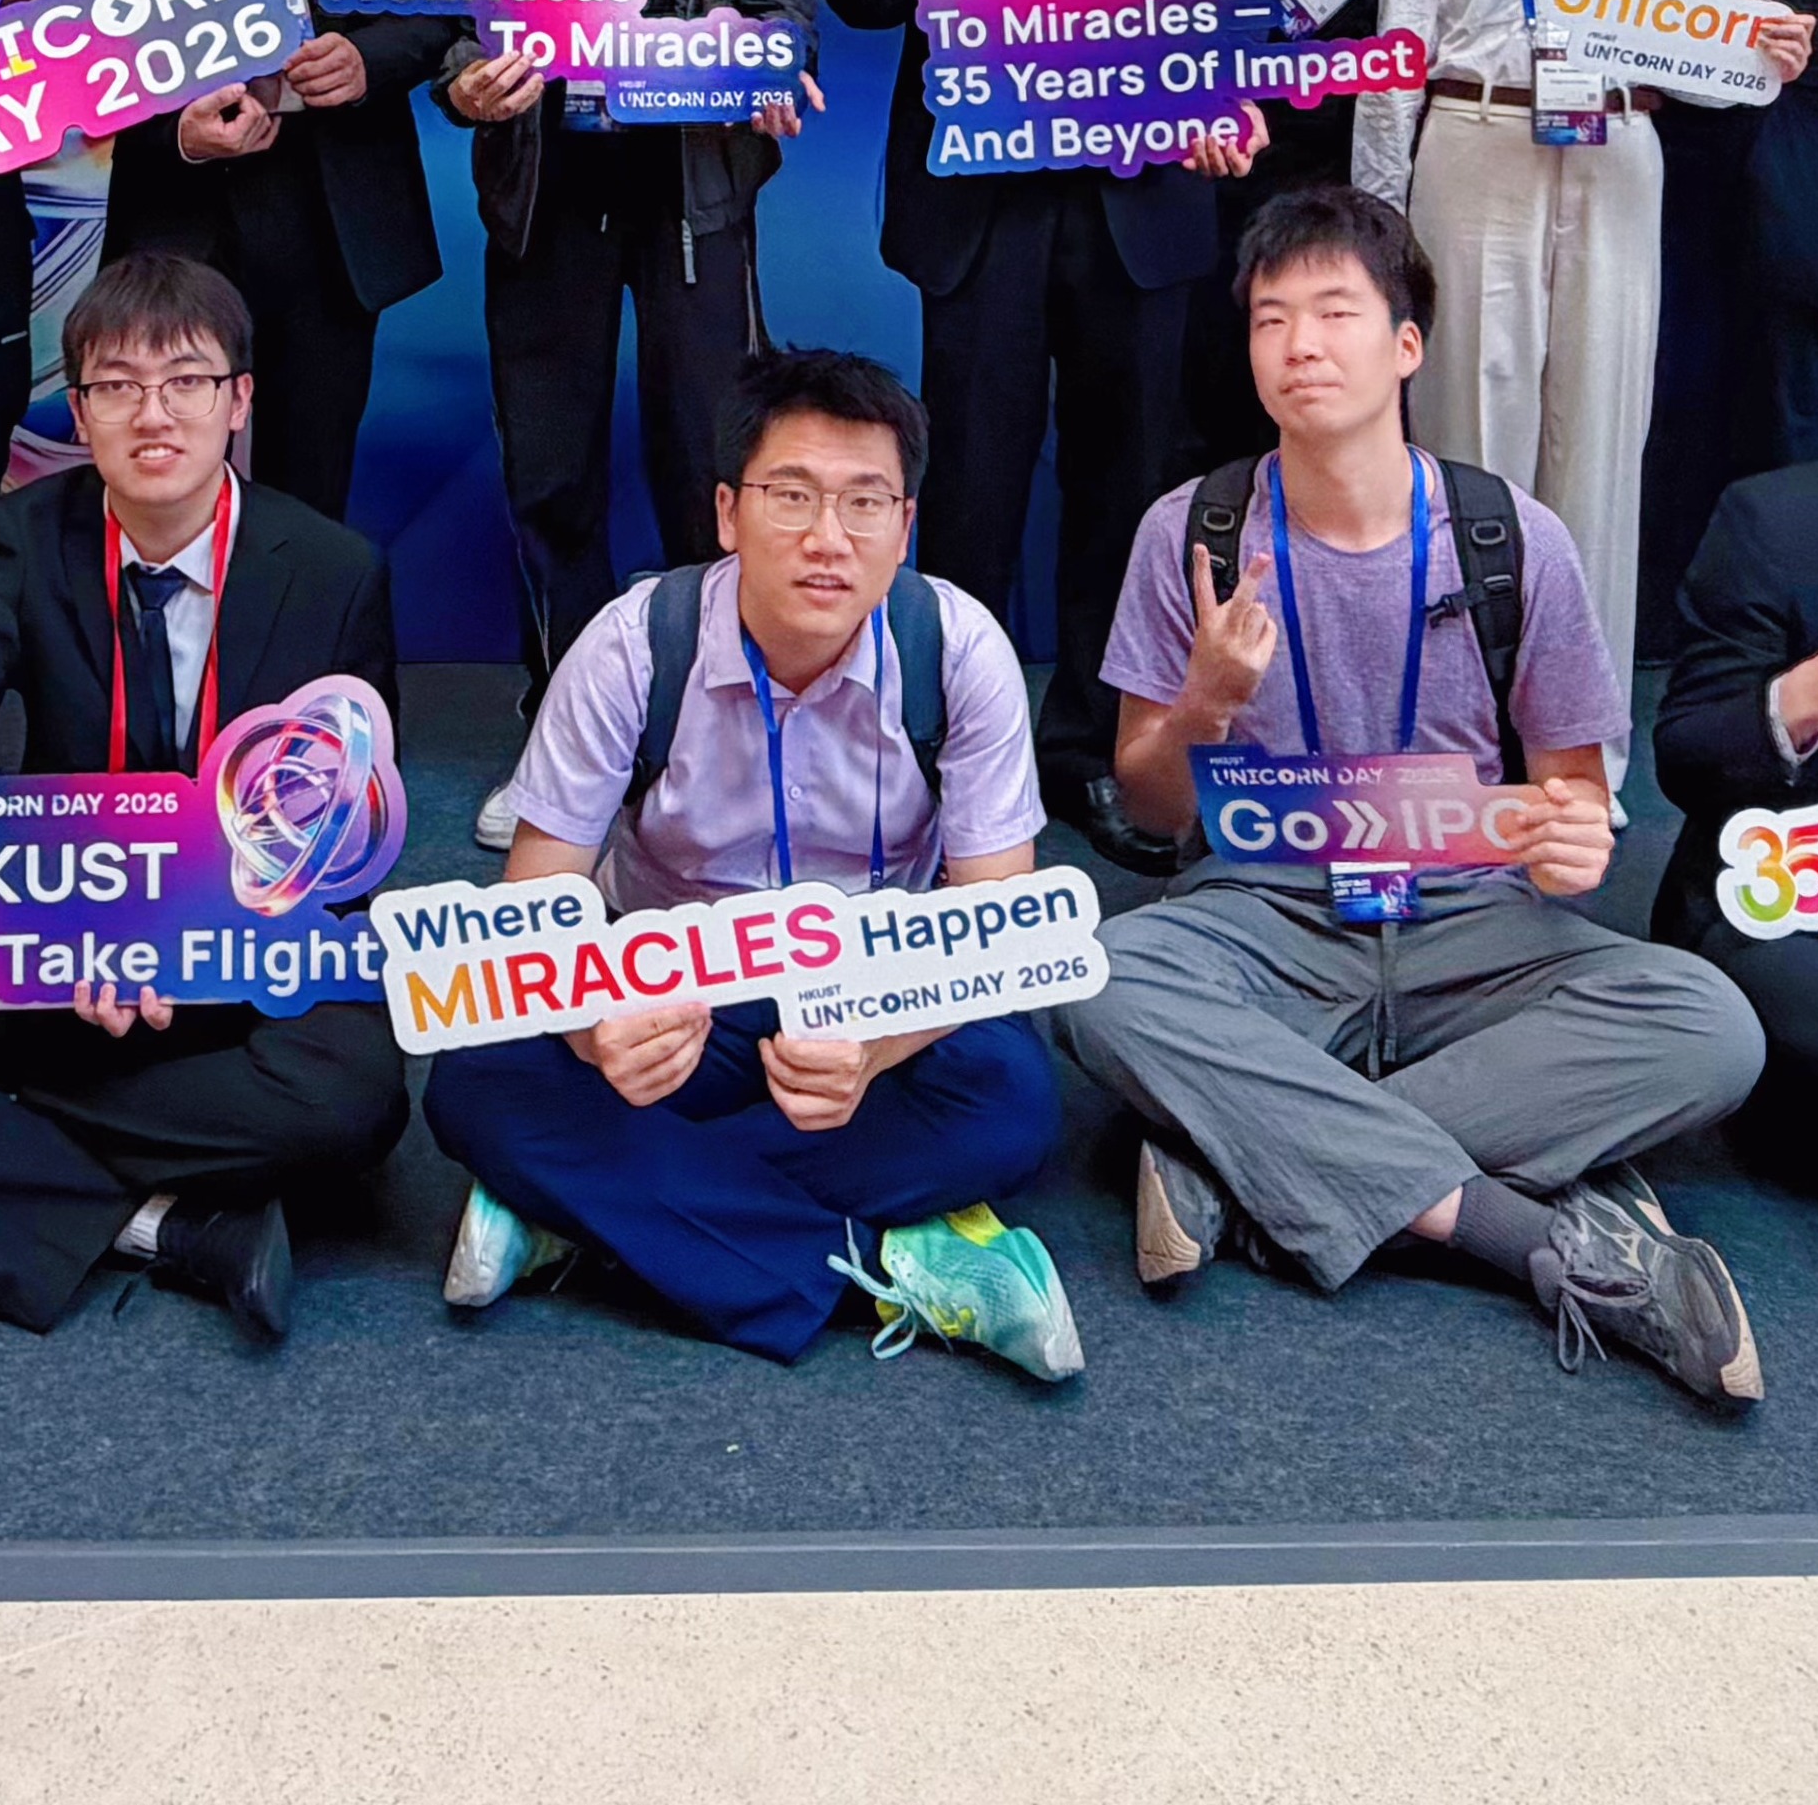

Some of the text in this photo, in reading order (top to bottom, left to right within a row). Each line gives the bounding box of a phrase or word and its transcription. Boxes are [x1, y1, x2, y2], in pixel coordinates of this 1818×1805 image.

[490, 20, 794, 67] To Miracles
[929, 0, 1218, 50] To Miracles
[88, 2, 281, 117] 2026
[935, 39, 1415, 107] 35 Years Of Impact
[938, 121, 1034, 164] And
[52, 794, 103, 817] DAY
[114, 792, 179, 815] 2026
[1219, 798, 1530, 851] Go IPO
[394, 894, 584, 952] Where
[182, 928, 378, 996] Flight
[404, 883, 1079, 1034] MIRACLES Happen
[798, 983, 842, 1003] HKUST
[801, 957, 1089, 1030] UNICORN DAY 2026
